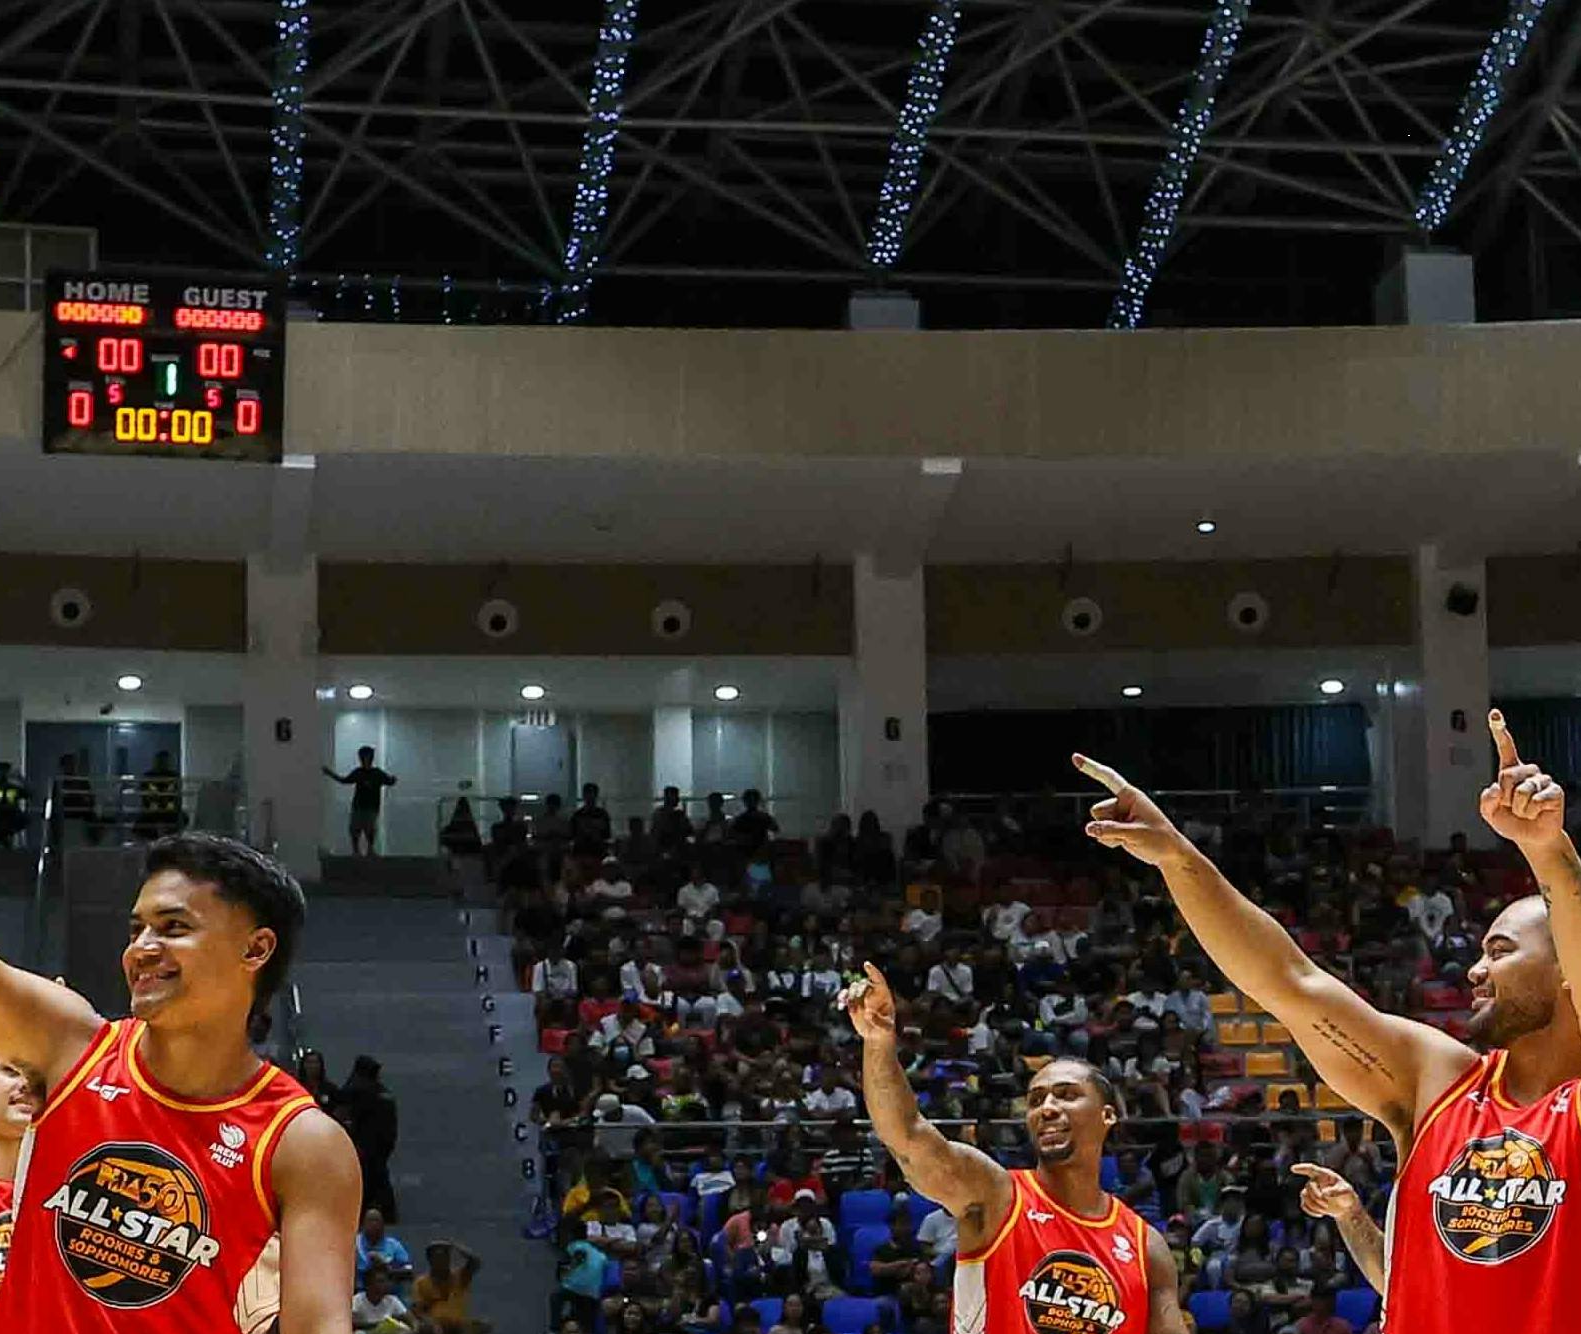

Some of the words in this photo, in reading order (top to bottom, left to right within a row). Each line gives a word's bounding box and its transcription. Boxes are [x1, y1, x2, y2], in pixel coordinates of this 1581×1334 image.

[64, 281, 150, 304] HOME
[183, 286, 268, 309] GUEST
[98, 337, 142, 373] 00
[199, 343, 243, 378] 00
[70, 391, 91, 426] 0
[116, 406, 213, 444] 00:00
[235, 399, 257, 433] 0
[208, 1141, 244, 1164] ARENA
[210, 1153, 235, 1169] PLUS
[1428, 1174, 1484, 1202] ALL
[1492, 1177, 1567, 1209] STAR
[43, 1183, 112, 1229] ALL
[118, 1209, 220, 1268] STAR
[69, 1238, 171, 1283] SOPHOMORES
[79, 1227, 146, 1261] ROOKIES
[148, 1252, 161, 1266] &
[1018, 1279, 1067, 1305] ALL
[1069, 1296, 1126, 1330] STAR
